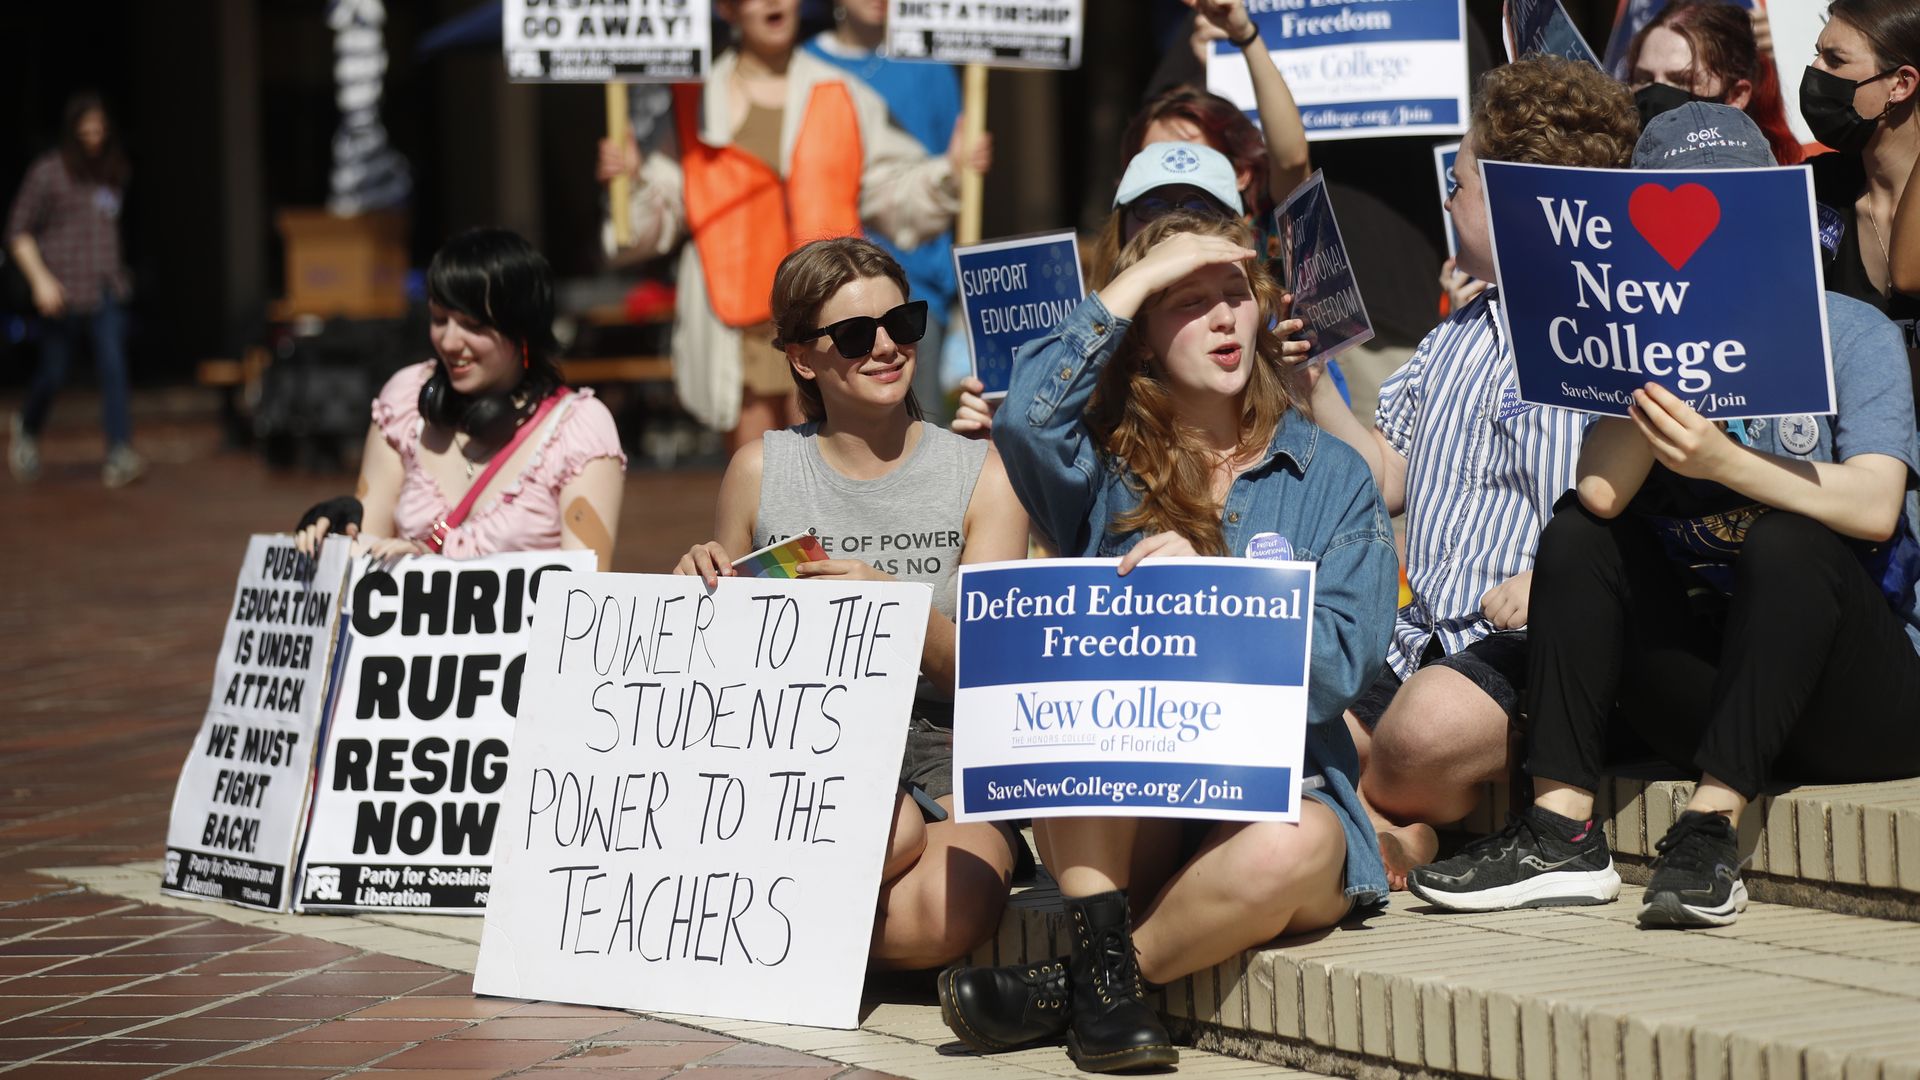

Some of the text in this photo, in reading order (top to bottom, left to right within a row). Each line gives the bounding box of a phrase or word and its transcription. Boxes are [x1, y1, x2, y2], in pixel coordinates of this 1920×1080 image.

[524, 16, 561, 38] GO
[1282, 7, 1391, 38] Freedom
[1320, 50, 1410, 84] College
[1302, 104, 1433, 128] College.org/Join
[1536, 195, 1613, 250] We
[963, 263, 1028, 296] SUPPORT
[1571, 260, 1690, 315] New
[1307, 286, 1359, 332] FREEDOM
[1548, 316, 1747, 393] College
[841, 536, 873, 553] OF
[880, 530, 960, 550] POWER
[906, 556, 941, 574] NO
[236, 588, 332, 627] EDUCATION
[965, 585, 1302, 622] Defend Educational
[234, 629, 313, 670] IS UNDER
[557, 588, 900, 680] POWER TO THE
[1042, 626, 1198, 658] Freedom
[224, 673, 305, 713] ATTACK
[586, 680, 848, 754] STUDENTS
[1013, 686, 1222, 743] New College
[206, 724, 299, 767] WE MUST
[1012, 733, 1096, 745] THE HONORS COLLEGE
[1101, 734, 1176, 752] of Florida
[332, 737, 509, 794] RESIG
[212, 769, 272, 809] FIGHT
[987, 776, 1243, 804] SaveNewCollege.org/Join
[352, 801, 500, 856] NOW
[525, 768, 845, 852] POWER TO THE
[201, 813, 261, 853] BACK!
[188, 853, 211, 878] Party
[358, 866, 400, 889] Party
[402, 866, 426, 886] for
[182, 874, 223, 897] Liberation
[304, 873, 342, 900] PSL
[355, 886, 431, 907] Liberation
[549, 865, 796, 967] TEACHERS
